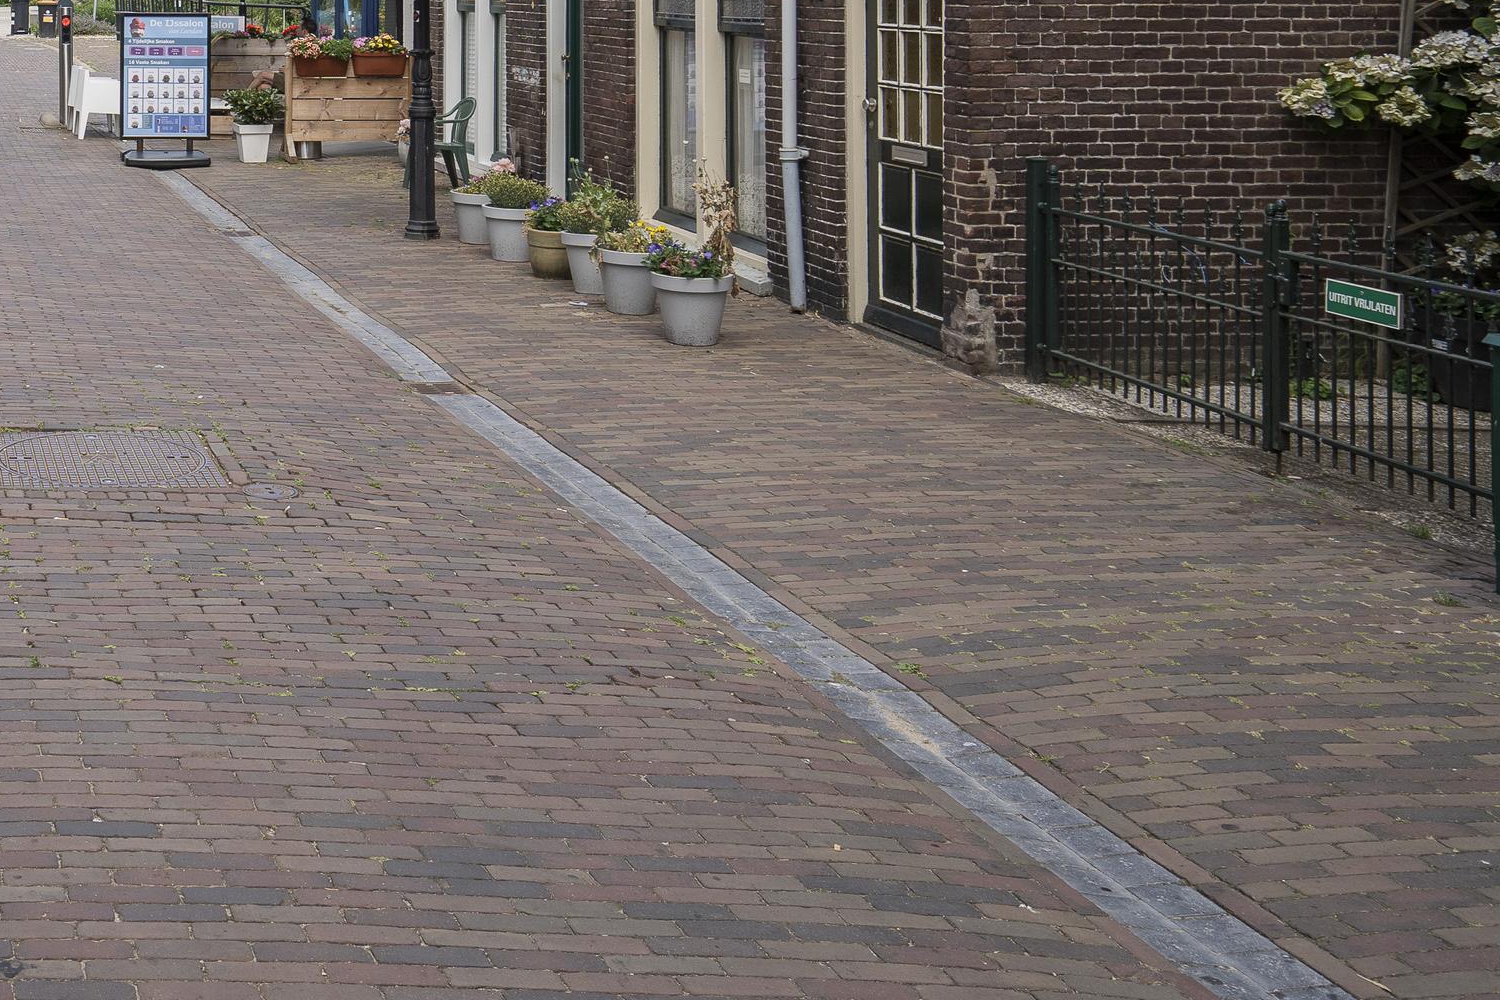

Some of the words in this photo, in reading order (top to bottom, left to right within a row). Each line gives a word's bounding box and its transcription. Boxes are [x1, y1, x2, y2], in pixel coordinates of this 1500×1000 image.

[150, 19, 162, 27] De
[165, 19, 203, 27] IJssalon
[1329, 292, 1353, 306] UITRIT
[1354, 297, 1396, 316] VRIJLATEN
